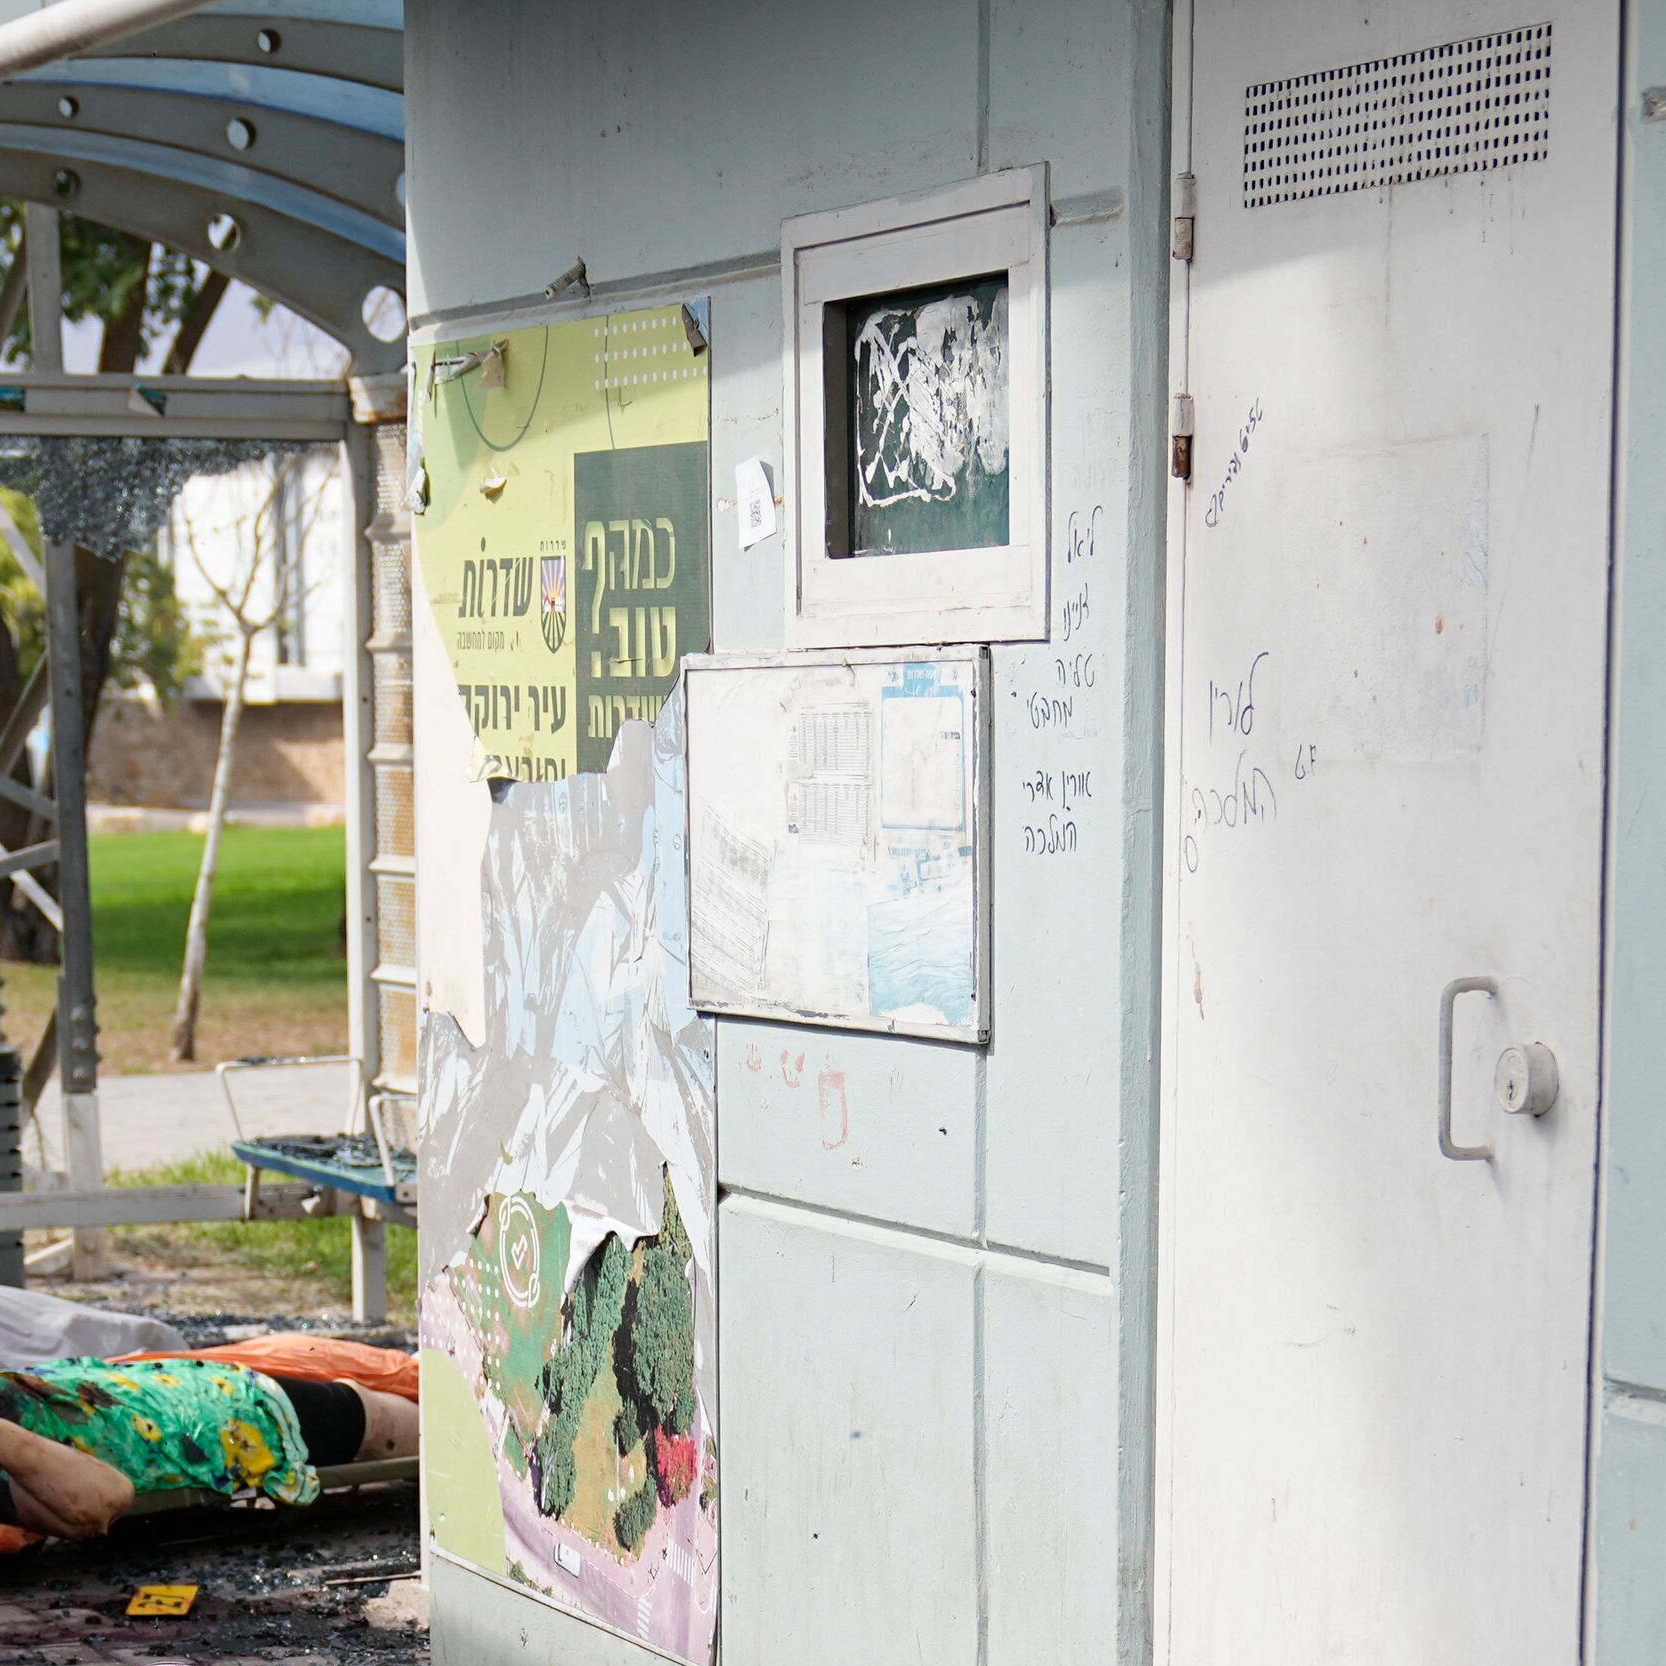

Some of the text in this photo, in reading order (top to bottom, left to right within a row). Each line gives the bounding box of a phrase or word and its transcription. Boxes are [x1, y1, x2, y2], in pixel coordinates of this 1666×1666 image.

[458, 536, 534, 618] שדרות
[608, 518, 675, 590] כמה
[457, 629, 504, 653] מקום למחשבה
[528, 685, 566, 734] עיר
[1024, 814, 1077, 855] המלכה
